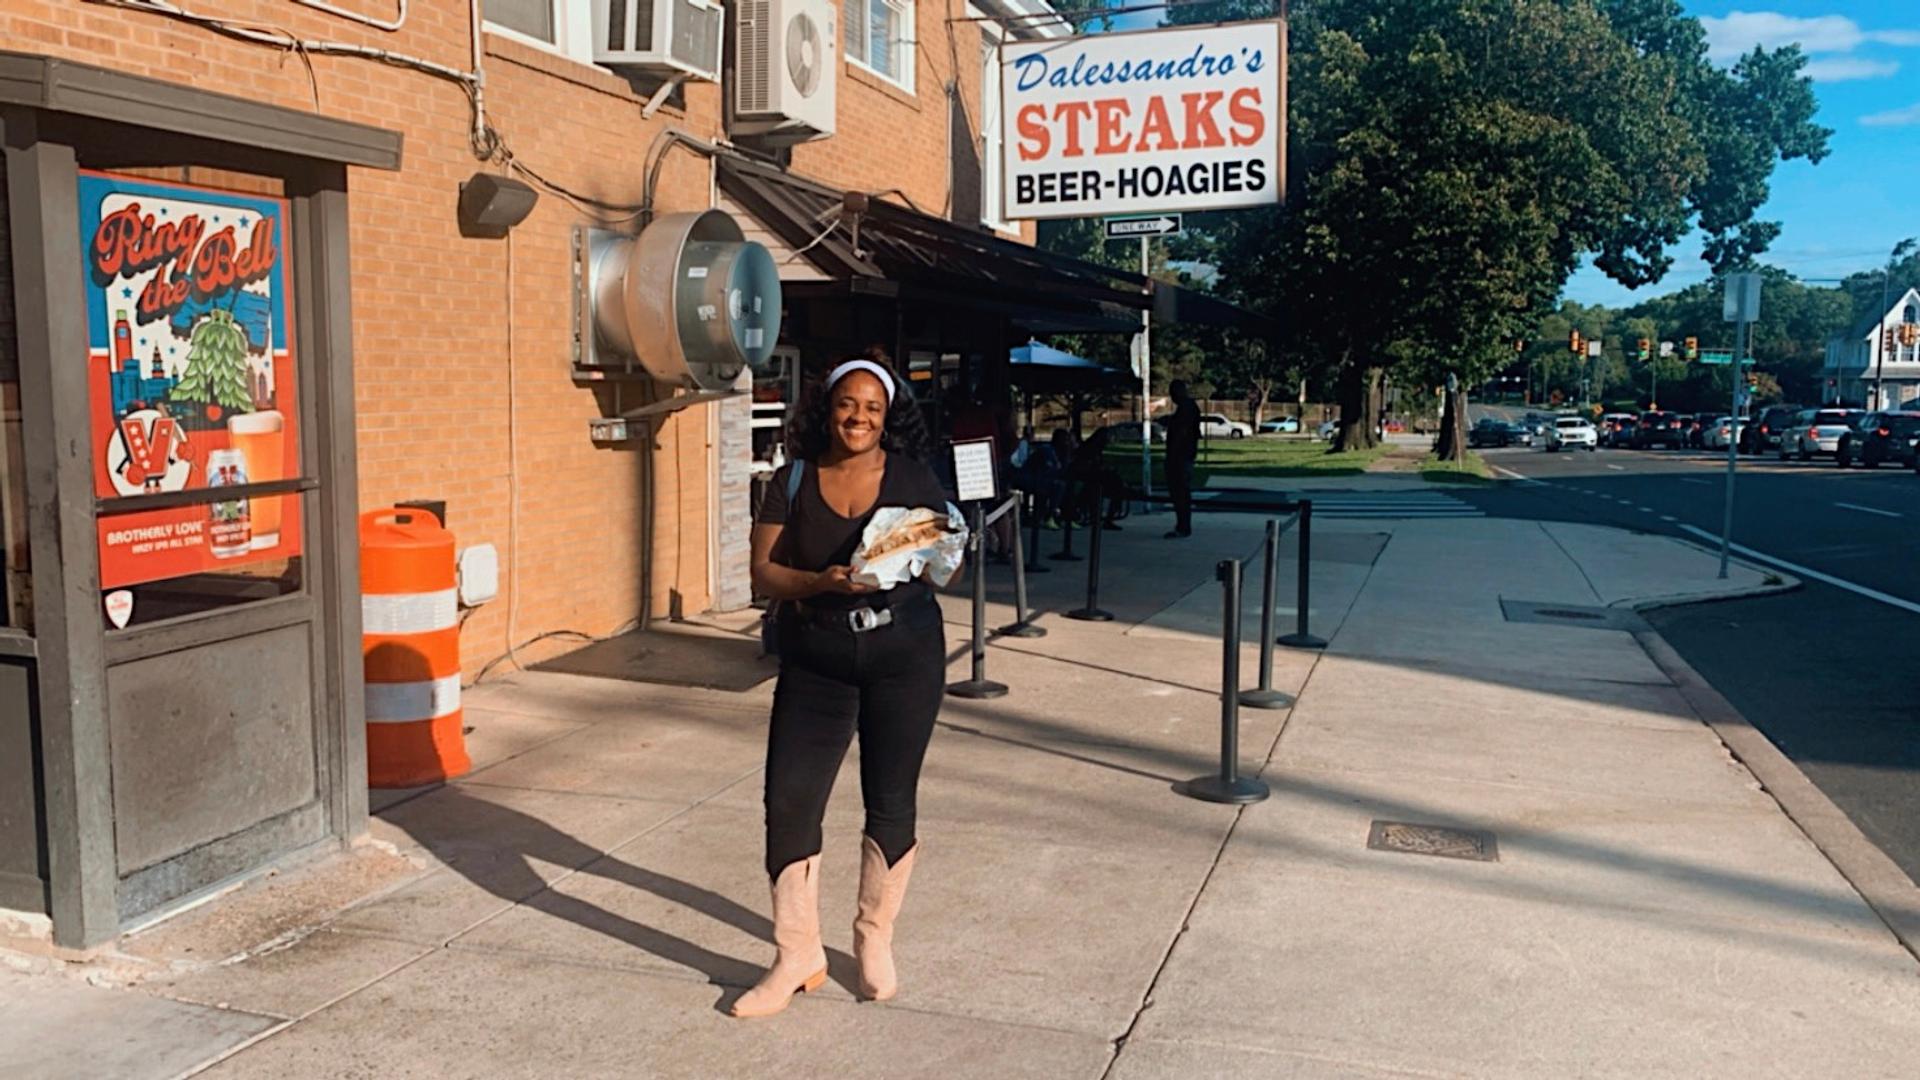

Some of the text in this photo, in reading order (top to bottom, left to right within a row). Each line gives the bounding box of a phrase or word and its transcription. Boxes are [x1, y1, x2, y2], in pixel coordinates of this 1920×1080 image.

[1015, 44, 1265, 92] Dalessandro's
[1016, 87, 1266, 161] STEAKS
[1016, 158, 1266, 204] BEER-HOAGIES
[1137, 222, 1159, 231] WAY
[94, 202, 277, 316] Ring the Bell
[107, 525, 173, 545] BROTHERLY
[175, 522, 203, 536] LOVE
